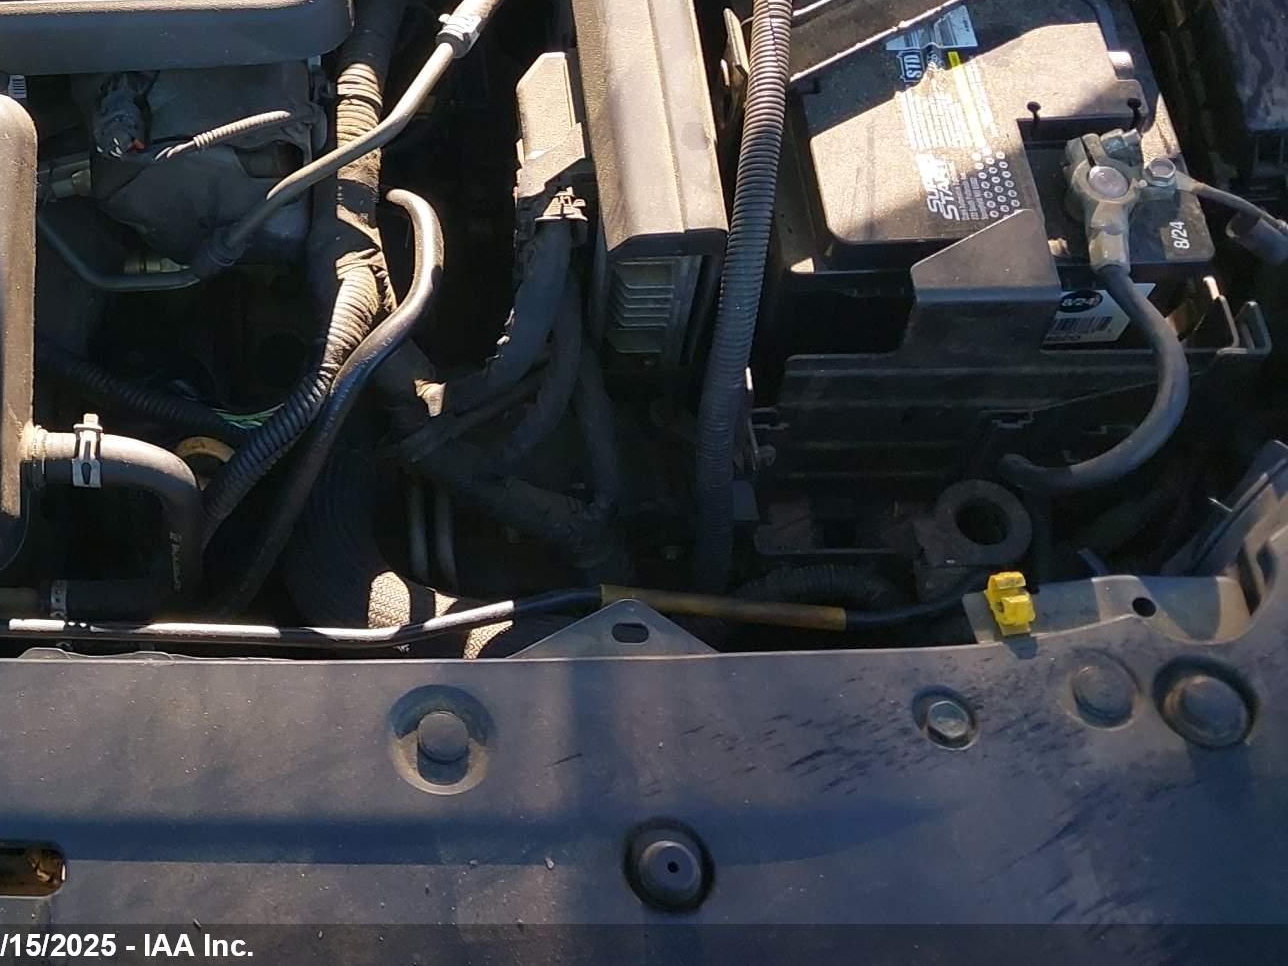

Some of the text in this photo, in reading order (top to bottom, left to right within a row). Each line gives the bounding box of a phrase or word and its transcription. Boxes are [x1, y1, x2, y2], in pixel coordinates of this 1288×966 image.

[904, 54, 923, 78] STD
[916, 155, 944, 212] SUP
[1169, 221, 1191, 250] 8/24
